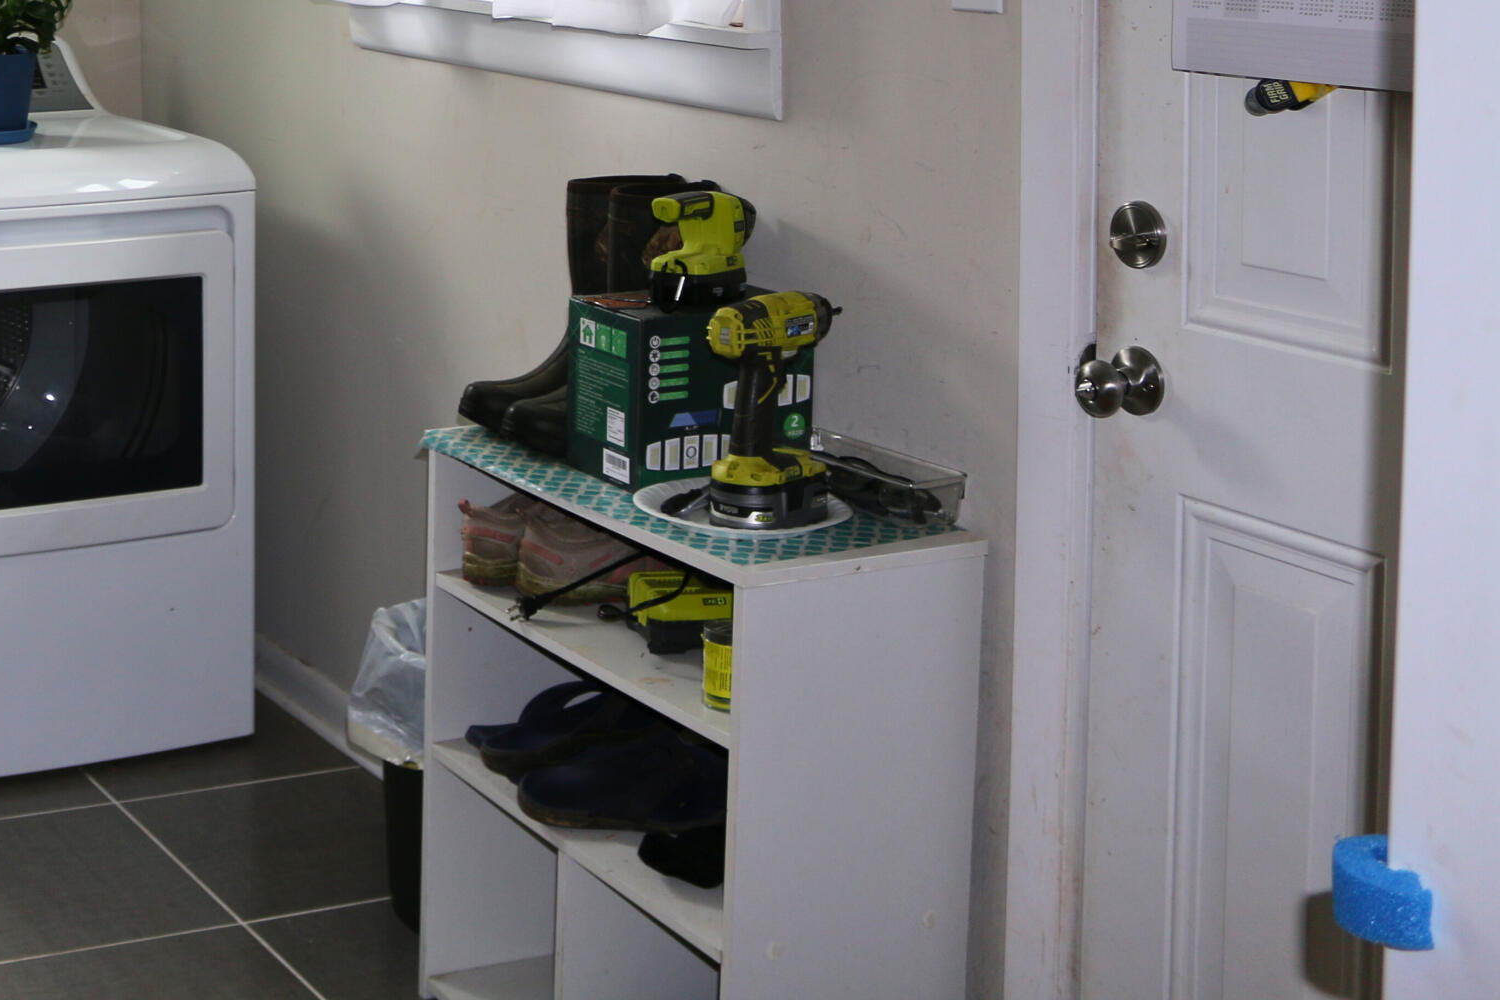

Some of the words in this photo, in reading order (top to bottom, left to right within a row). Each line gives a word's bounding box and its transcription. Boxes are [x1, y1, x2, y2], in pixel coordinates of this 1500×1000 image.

[1262, 83, 1280, 104] FIRM
[1272, 81, 1289, 101] GRIP
[790, 415, 799, 428] 2
